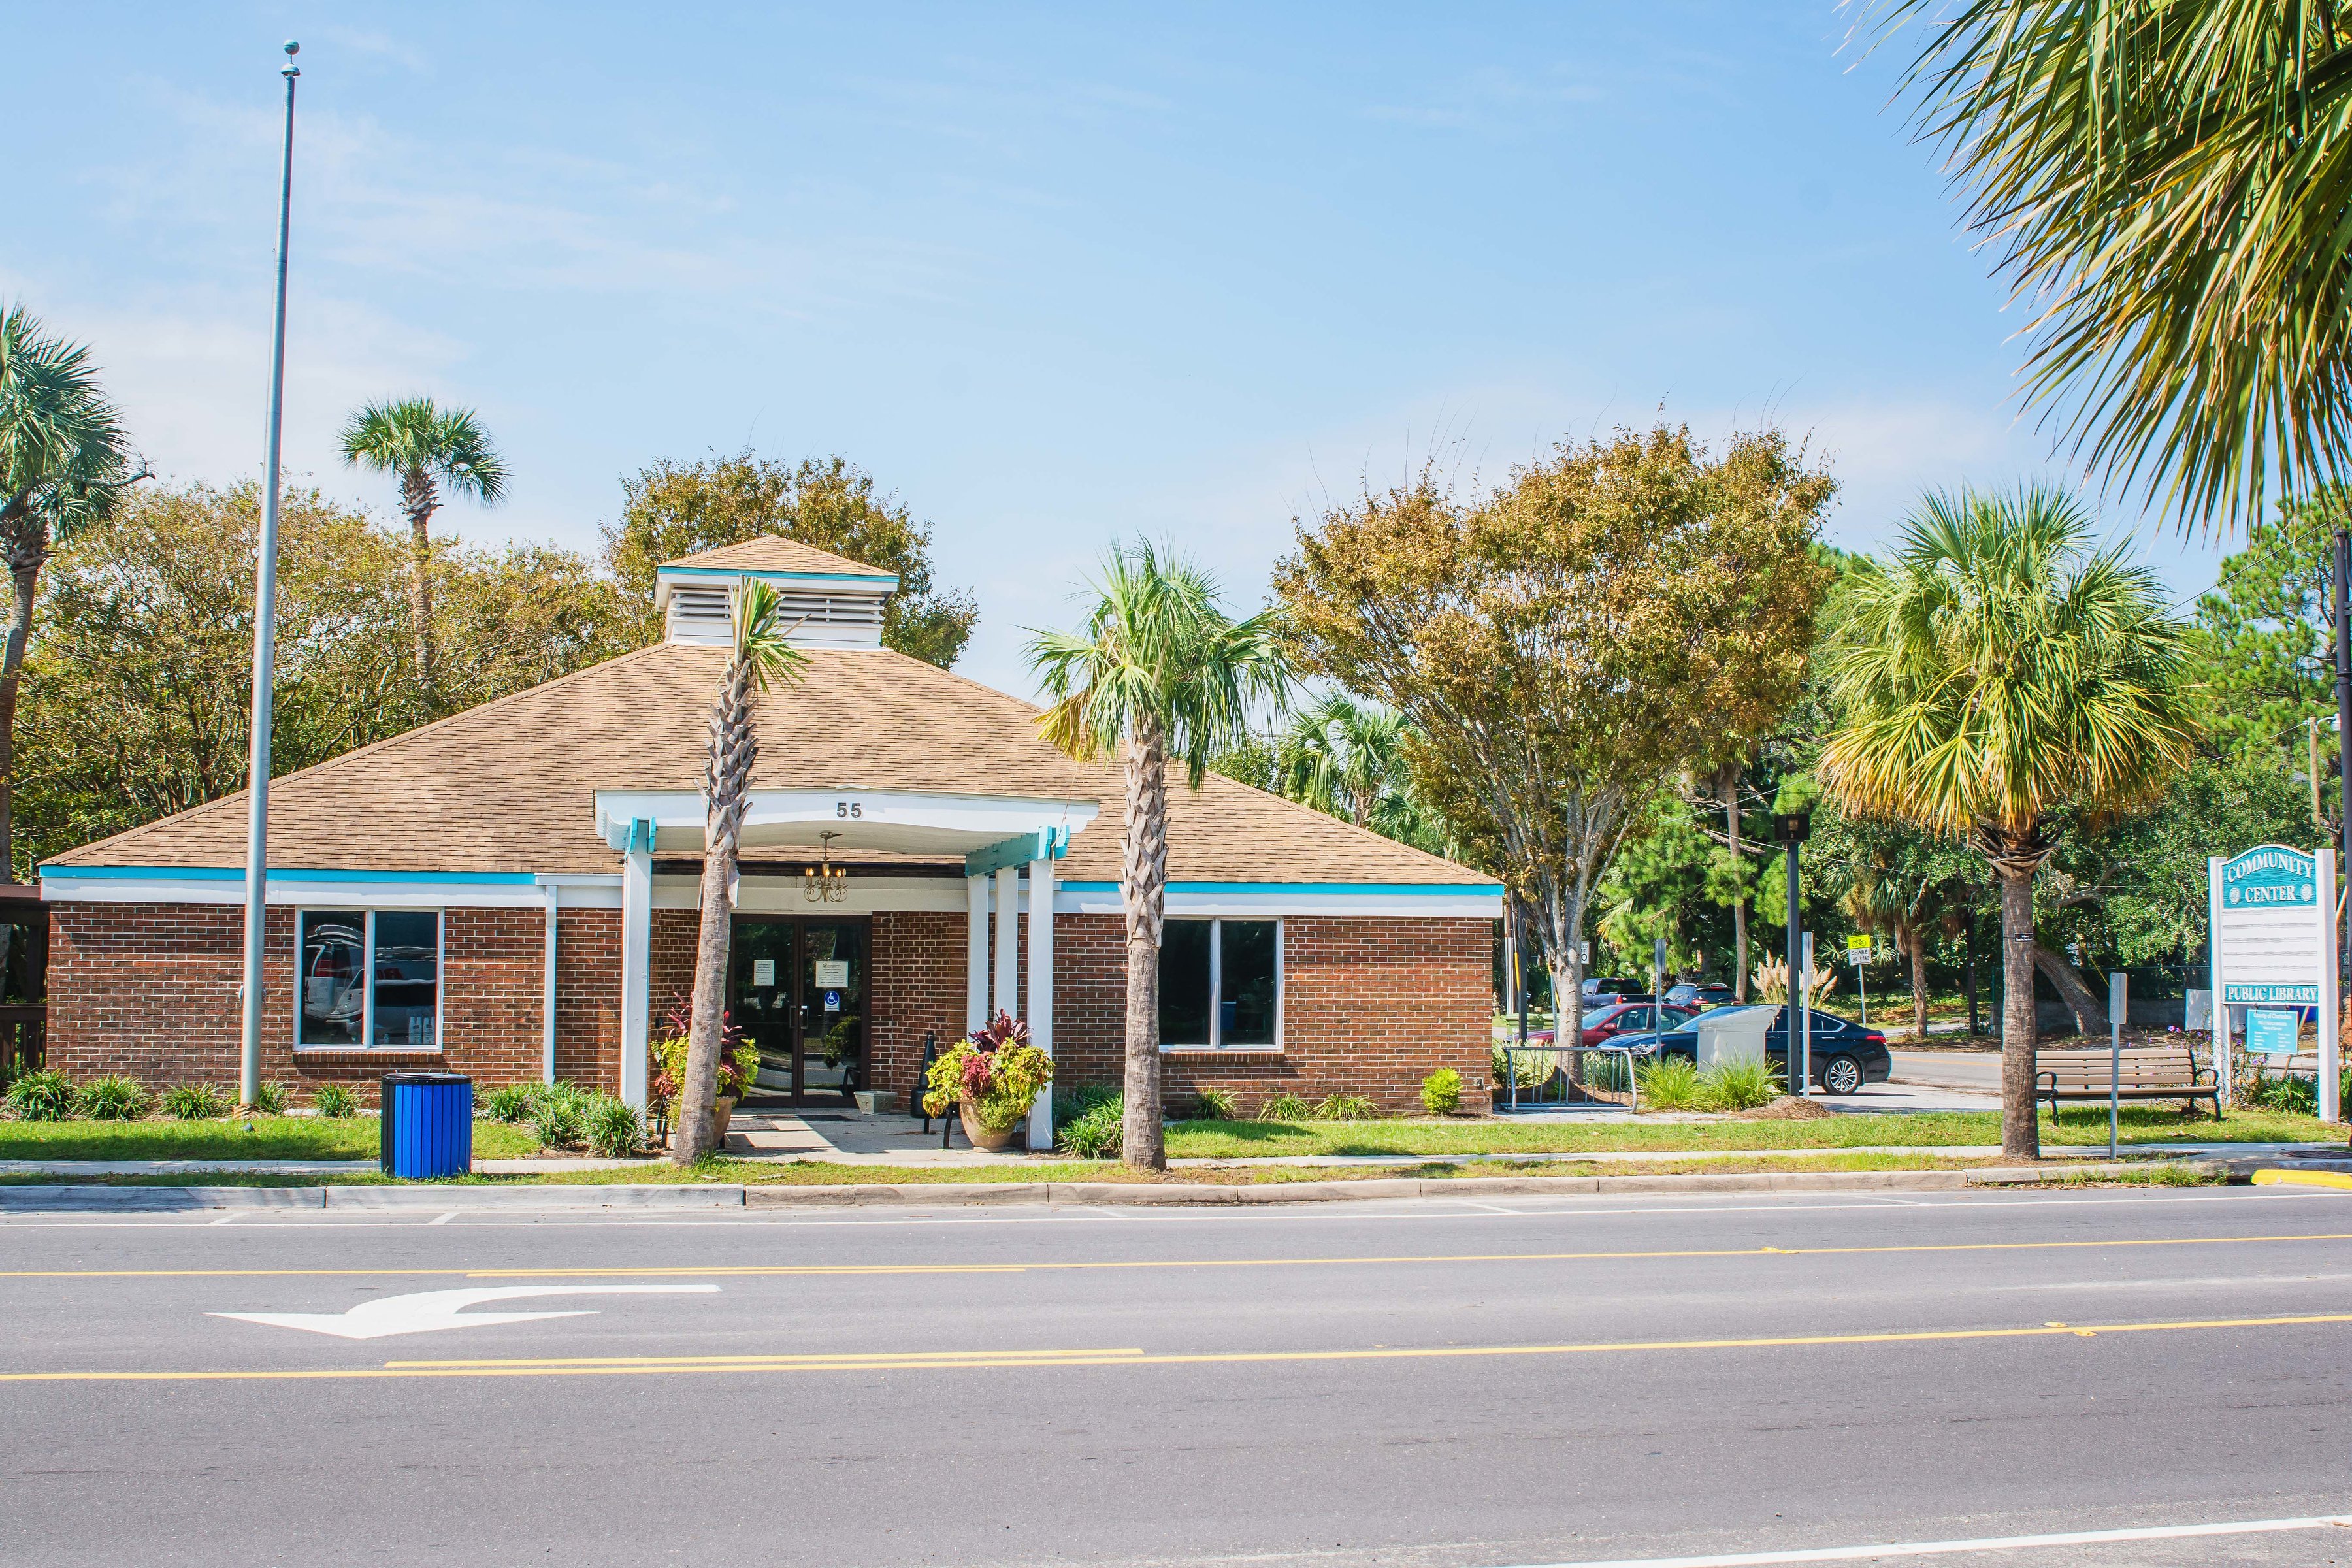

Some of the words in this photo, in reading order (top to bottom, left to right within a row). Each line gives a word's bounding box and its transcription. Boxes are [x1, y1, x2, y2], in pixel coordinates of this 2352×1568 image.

[836, 802, 862, 818] 55
[2227, 852, 2313, 883] COMMUNITY
[2244, 885, 2296, 902] CENTER
[2227, 987, 2267, 1000] PUBLIC
[2268, 987, 2317, 1001] LIBRARY
